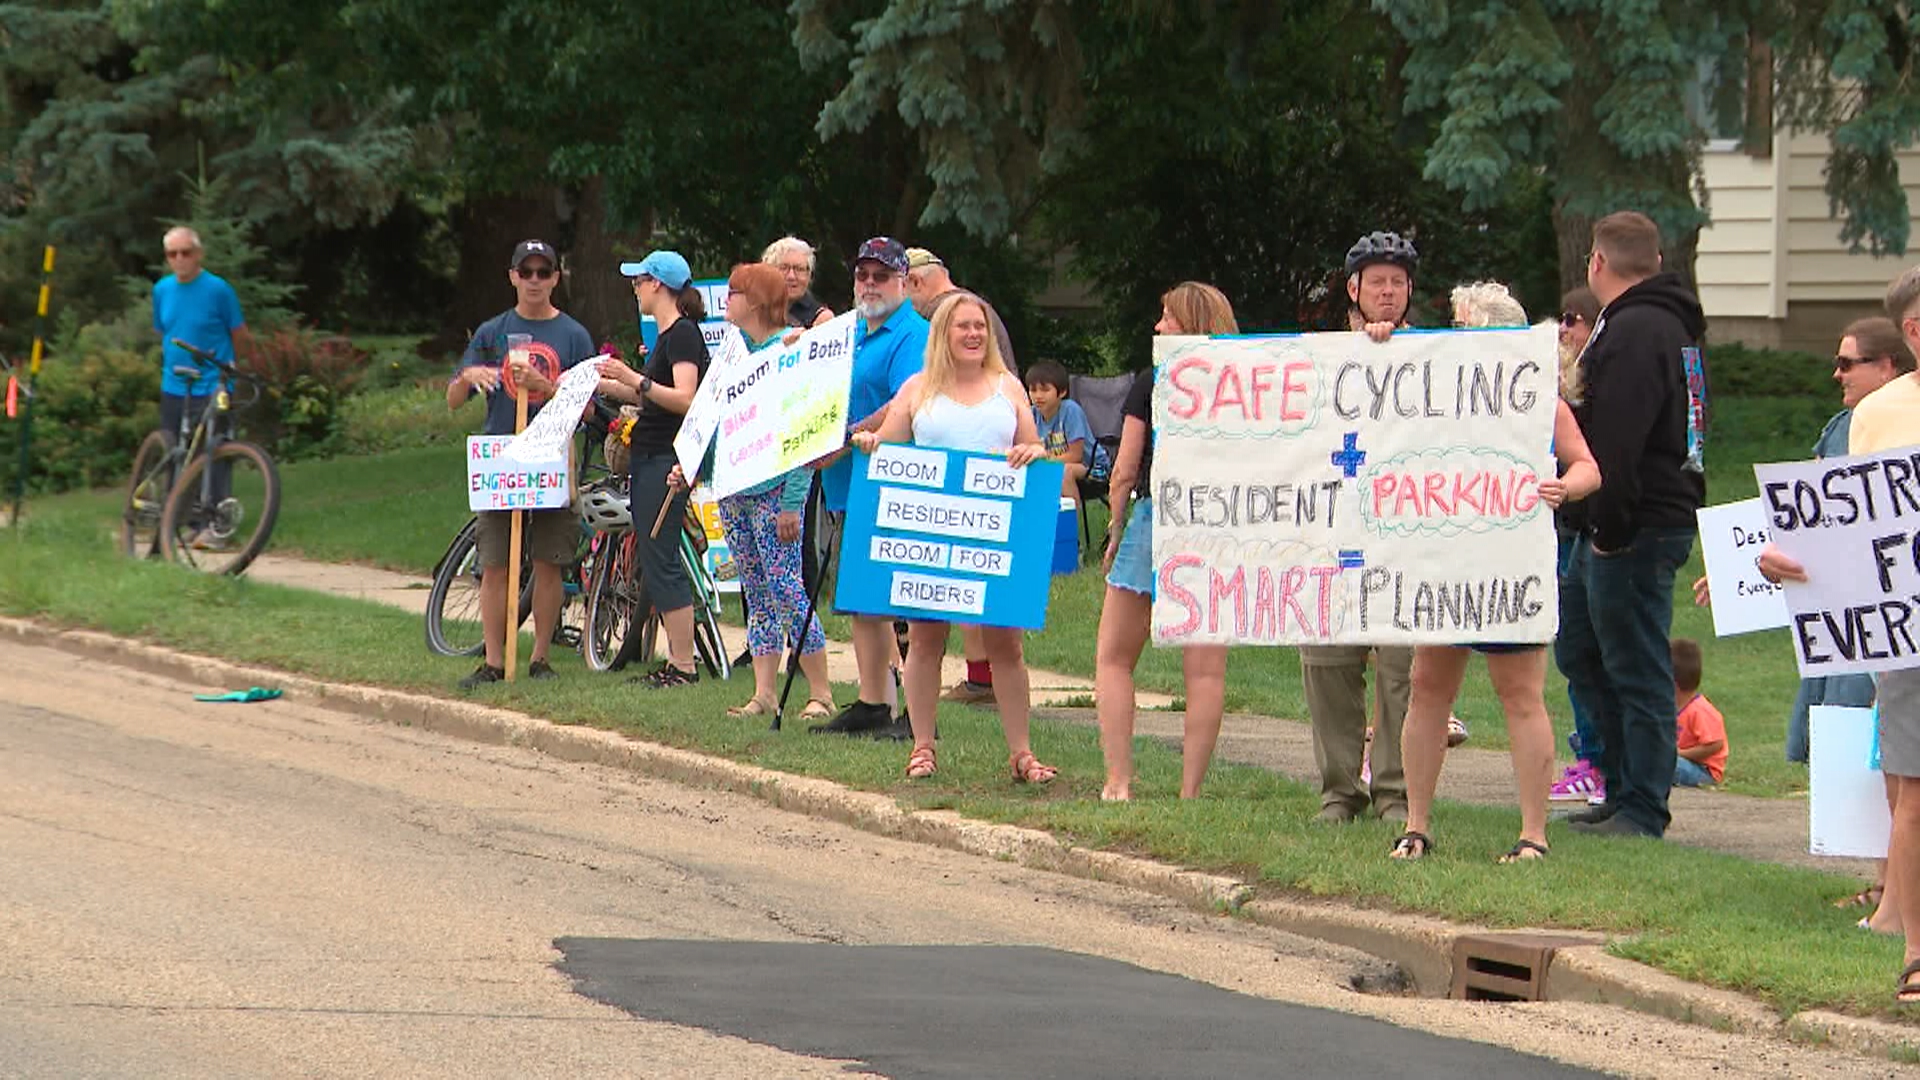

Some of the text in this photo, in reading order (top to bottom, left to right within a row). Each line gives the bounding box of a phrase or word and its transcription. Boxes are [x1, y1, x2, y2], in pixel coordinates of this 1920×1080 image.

[726, 360, 770, 404] Room
[808, 325, 851, 361] Both!
[1167, 356, 1541, 422] SAFE CYCLING
[723, 404, 758, 438] Bike
[782, 404, 838, 456] Parking
[472, 443, 507, 459] REA
[729, 432, 774, 466] Lanes
[471, 472, 566, 492] ENGAGEMENT
[875, 458, 1016, 492] ROOM FOR
[491, 491, 545, 508] PLEASE
[1159, 469, 1540, 527] RESIDENT PARKING
[887, 501, 1001, 530] RESIDENTS
[879, 541, 1001, 570] ROOM FOR
[899, 581, 976, 605] RIDERS
[1158, 551, 1543, 639] SMART PLANNING
[1795, 595, 1920, 664] EVER
